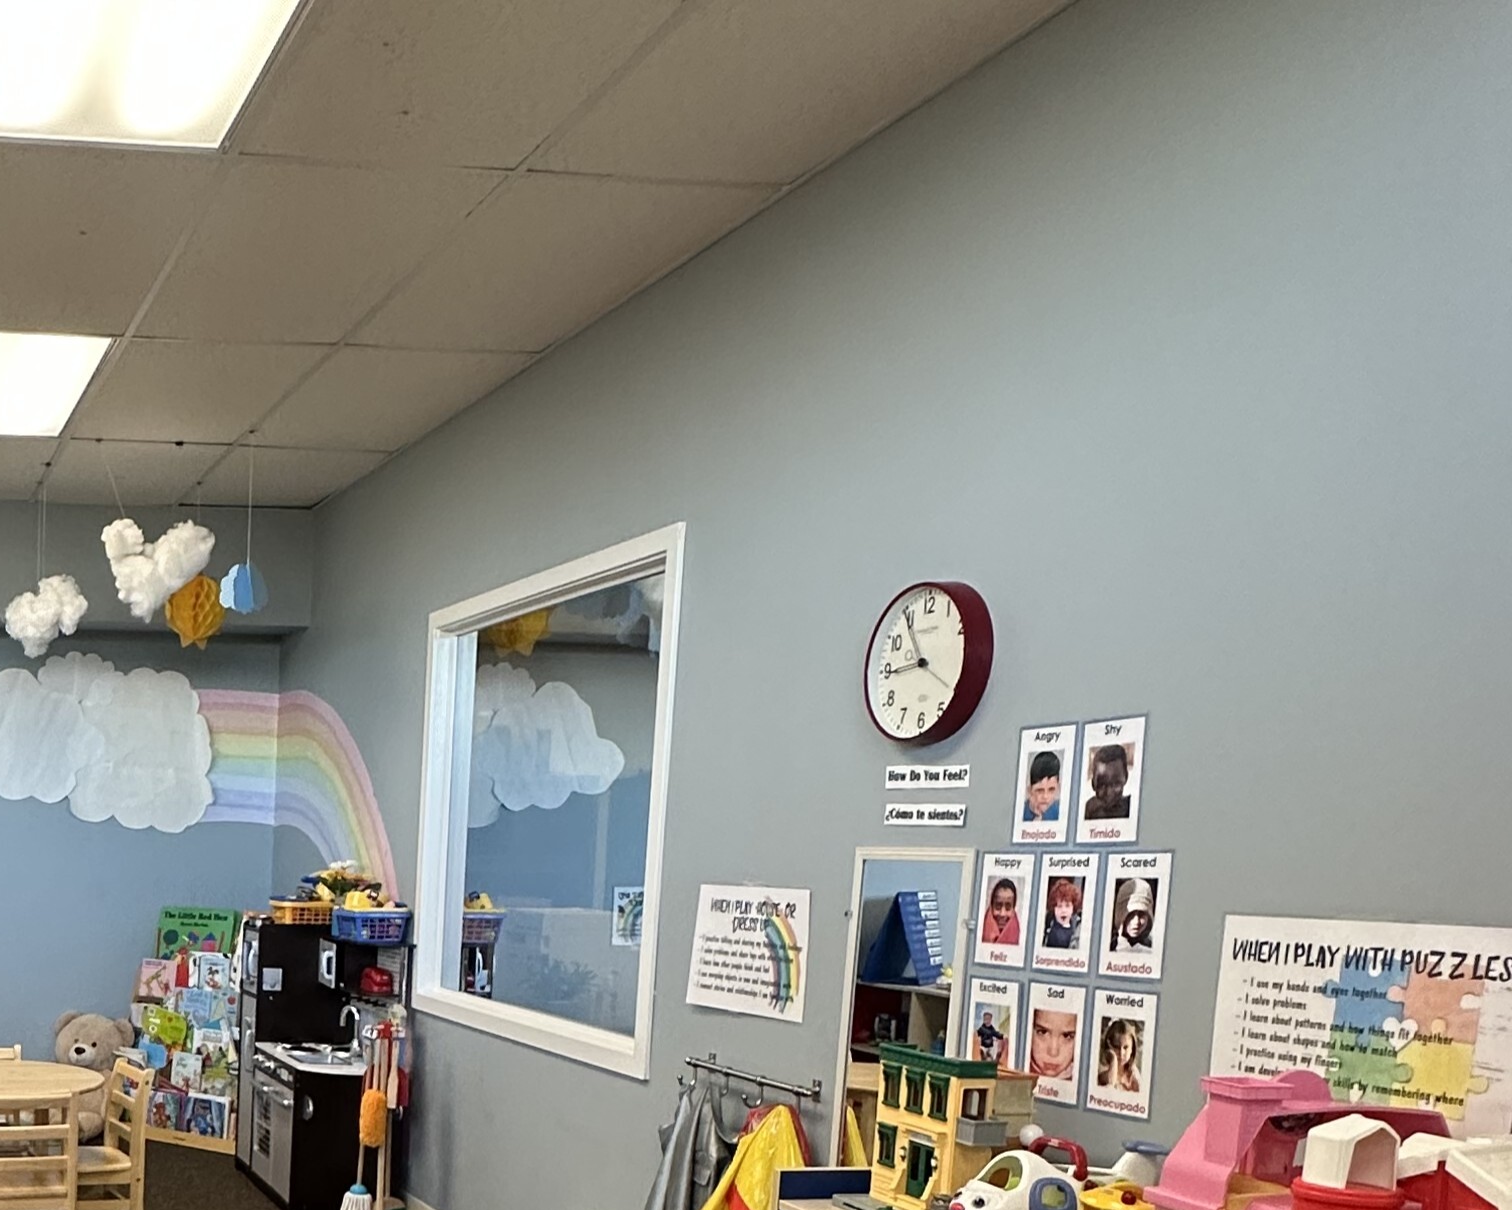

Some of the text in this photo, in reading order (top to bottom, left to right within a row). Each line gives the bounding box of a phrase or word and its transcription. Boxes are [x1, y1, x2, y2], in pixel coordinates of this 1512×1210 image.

[924, 596, 936, 614] 12
[891, 634, 902, 652] 10
[884, 663, 892, 679] 9
[886, 690, 895, 707] 8
[900, 708, 907, 724] 7
[937, 702, 945, 718] 5
[917, 712, 925, 729] 6
[1035, 732, 1061, 743] Angry
[1105, 725, 1122, 736] Shy
[888, 769, 968, 781] How Do You Feel?
[917, 810, 925, 820] te
[1021, 830, 1057, 842] Enojado
[995, 858, 1023, 869] Happy
[1049, 857, 1090, 870] Surprised
[1120, 857, 1157, 868] Scared
[178, 912, 196, 920] Little
[198, 913, 212, 921] Red
[735, 900, 754, 916] PLAY
[784, 902, 797, 919] OR
[732, 917, 760, 933] DRESS
[990, 951, 1008, 963] Feliz
[1035, 955, 1086, 969] Sorprendido
[1233, 937, 1281, 966] WHEN
[1284, 943, 1291, 966] I
[1294, 942, 1340, 969] PLAY
[1345, 944, 1396, 972] WITH
[1106, 960, 1153, 976] Asustado
[979, 982, 1008, 995] Excited
[1047, 988, 1065, 999] Sad
[1272, 982, 1284, 994] my
[1287, 980, 1310, 993] hands
[1313, 983, 1328, 994] and
[1352, 987, 1387, 1001] together
[1106, 994, 1144, 1008] Worried
[1252, 995, 1270, 1006] solve
[1273, 996, 1307, 1011] problems
[1250, 1011, 1269, 1023] learn
[1272, 1014, 1293, 1026] about
[1295, 1018, 1327, 1031] patterns
[1330, 1020, 1346, 1033] and
[1348, 1021, 1365, 1034] how
[1369, 1028, 1395, 1041] things
[1398, 1028, 1410, 1040] fit
[1414, 1032, 1454, 1046] together
[1248, 1028, 1267, 1041] learn
[1270, 1031, 1291, 1044] about
[1293, 1034, 1319, 1049] shapes
[1321, 1040, 1336, 1050] and
[1340, 1041, 1356, 1052] how
[1359, 1043, 1368, 1054] to
[1371, 1046, 1398, 1058] match
[1246, 1047, 1275, 1059] practice
[1278, 1052, 1298, 1066] using
[1301, 1055, 1313, 1068] my
[1244, 1065, 1256, 1074] am
[1038, 1084, 1060, 1098] Triste
[1372, 1085, 1432, 1105] remembering
[1434, 1092, 1465, 1107] where
[1089, 1094, 1146, 1114] Preocupado
